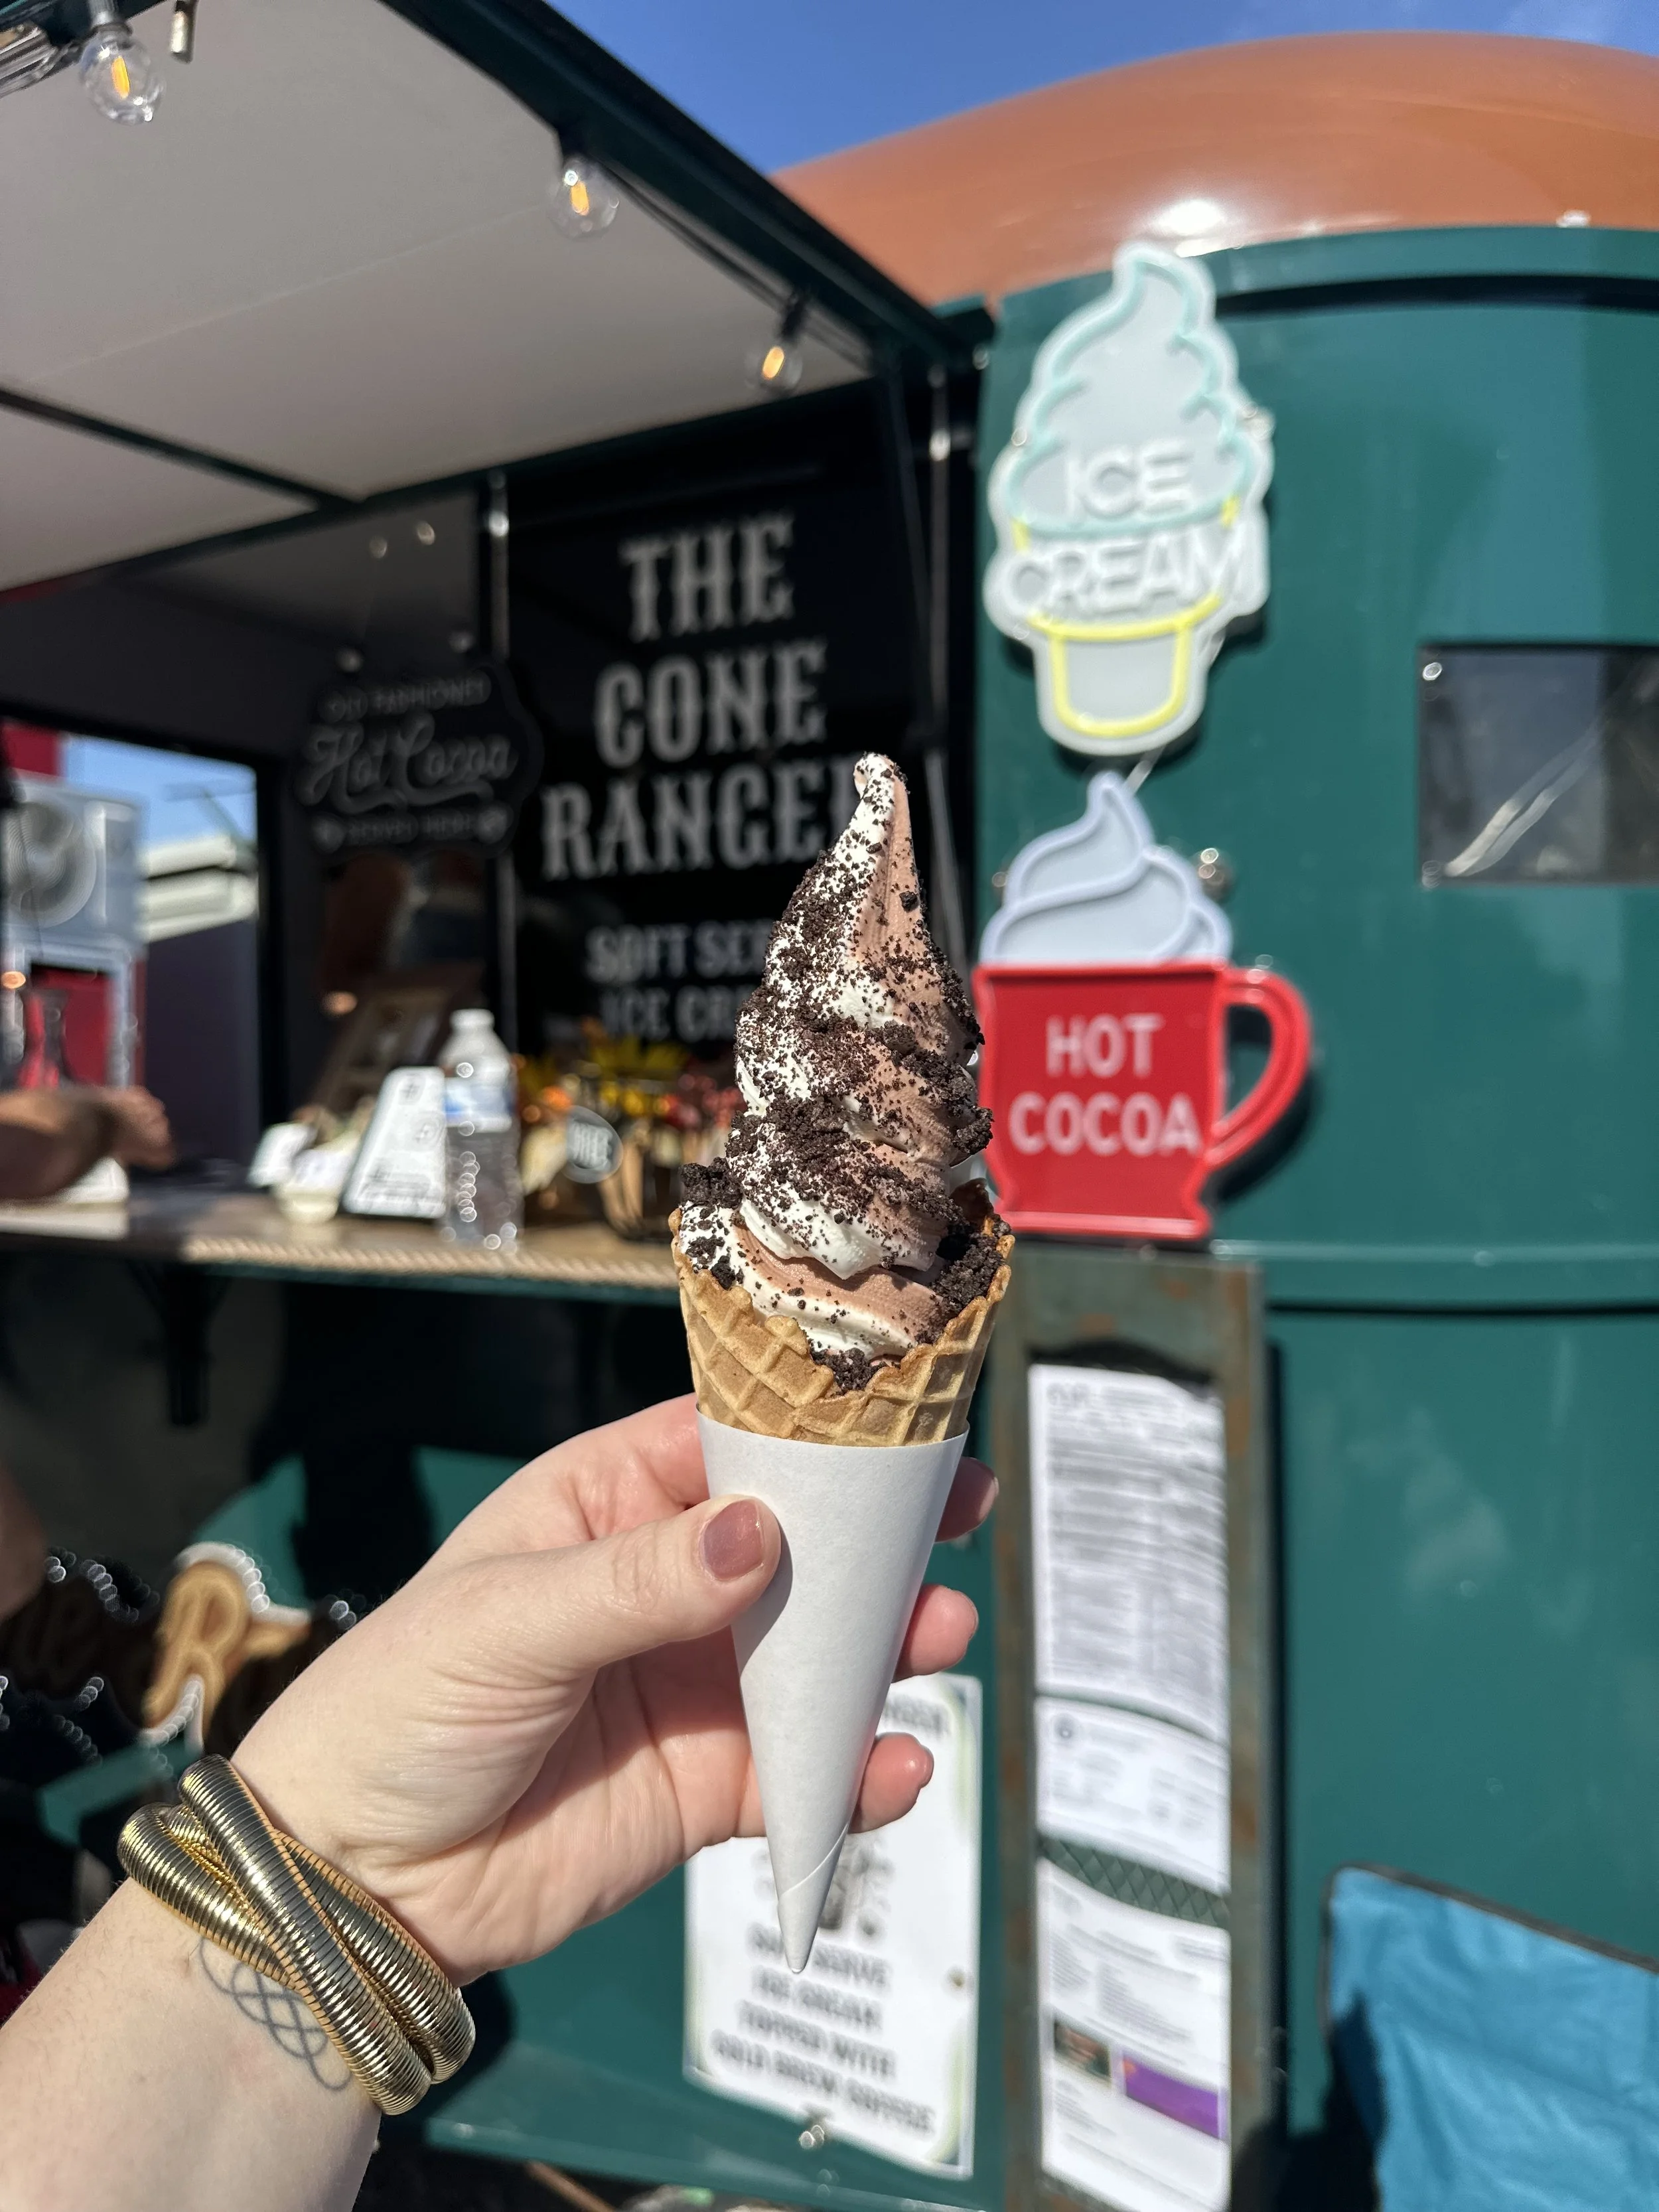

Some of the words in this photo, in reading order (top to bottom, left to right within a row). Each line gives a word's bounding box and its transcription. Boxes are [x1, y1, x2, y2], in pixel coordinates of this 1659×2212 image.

[1066, 438, 1192, 519] ICE
[620, 515, 794, 642] THE
[1007, 523, 1252, 616] CREAM
[594, 640, 828, 768] CONE
[297, 723, 399, 814] Hot
[390, 712, 519, 804] Cocoa
[585, 924, 690, 982] SOFT
[601, 987, 671, 1040] ICE
[676, 984, 754, 1043] CR
[1046, 1013, 1164, 1078] HOT
[1009, 1091, 1204, 1157] COCOA
